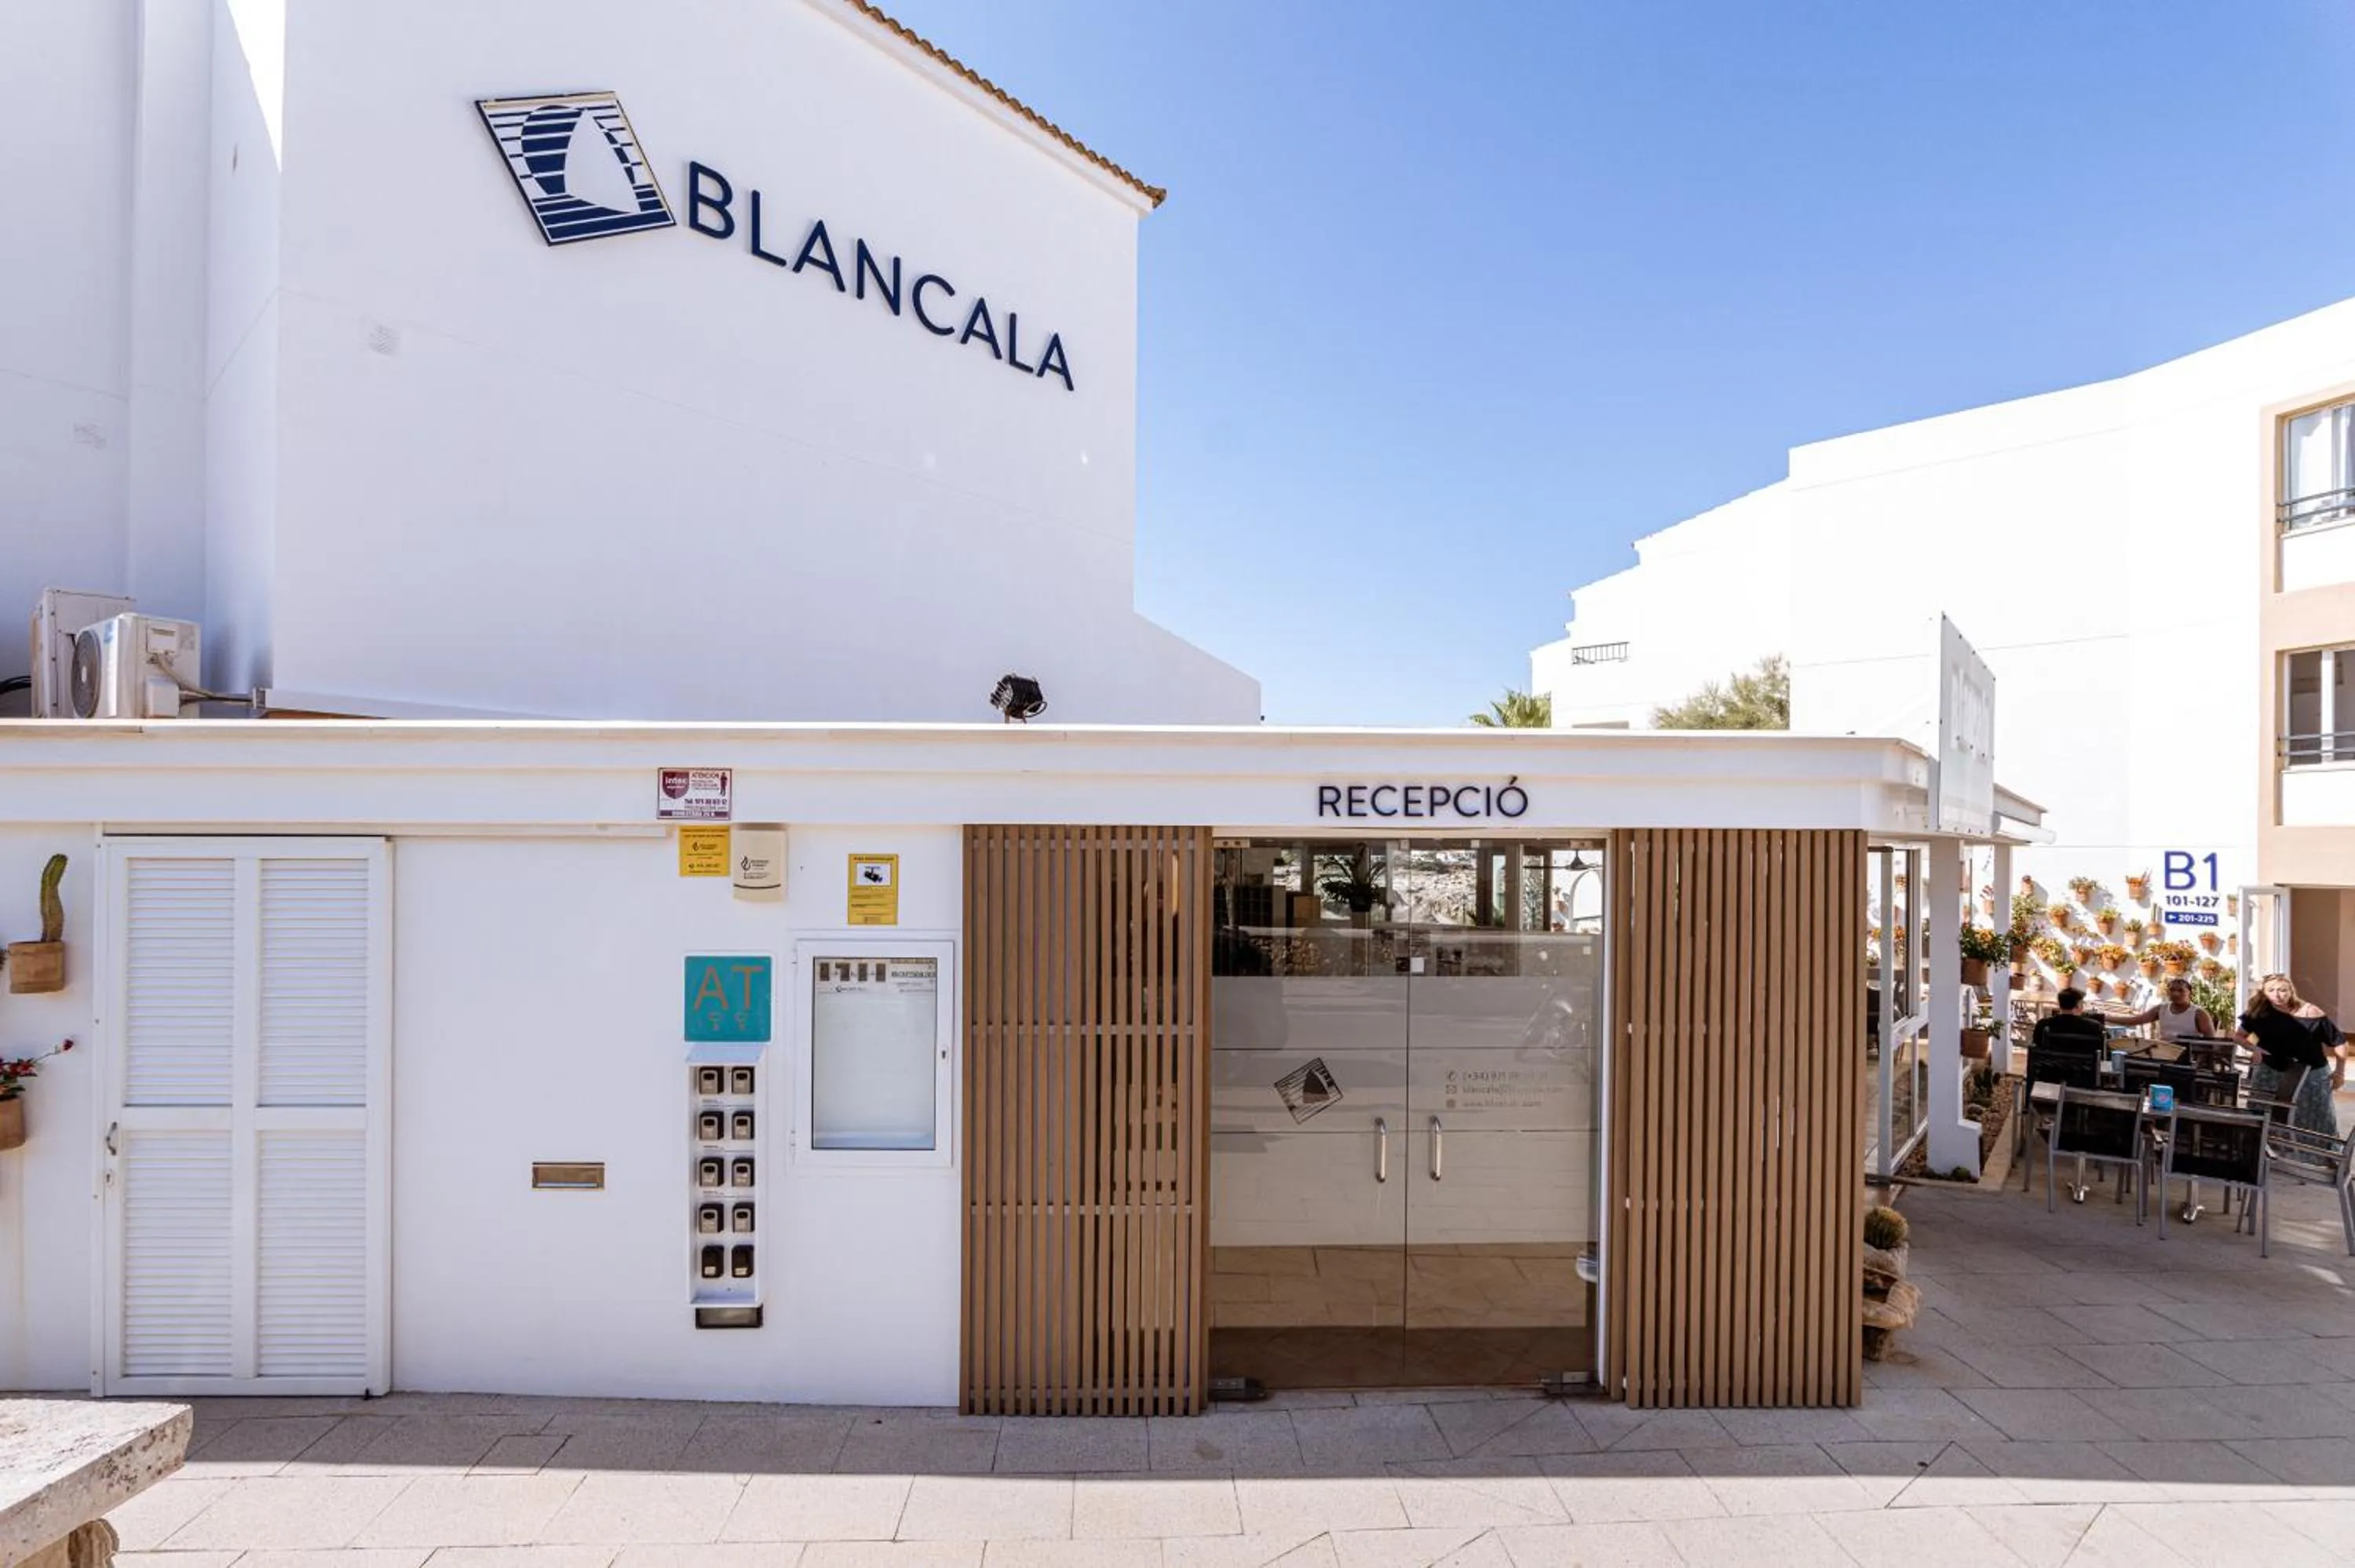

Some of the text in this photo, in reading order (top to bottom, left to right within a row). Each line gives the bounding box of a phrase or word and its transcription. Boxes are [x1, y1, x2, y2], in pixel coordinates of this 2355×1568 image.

[688, 160, 1075, 392] BLANCALA
[1318, 775, 1528, 818] RECEPCIÓ
[2164, 851, 2218, 892] B1
[2166, 895, 2220, 907] 101-127
[694, 966, 765, 1011] AT
